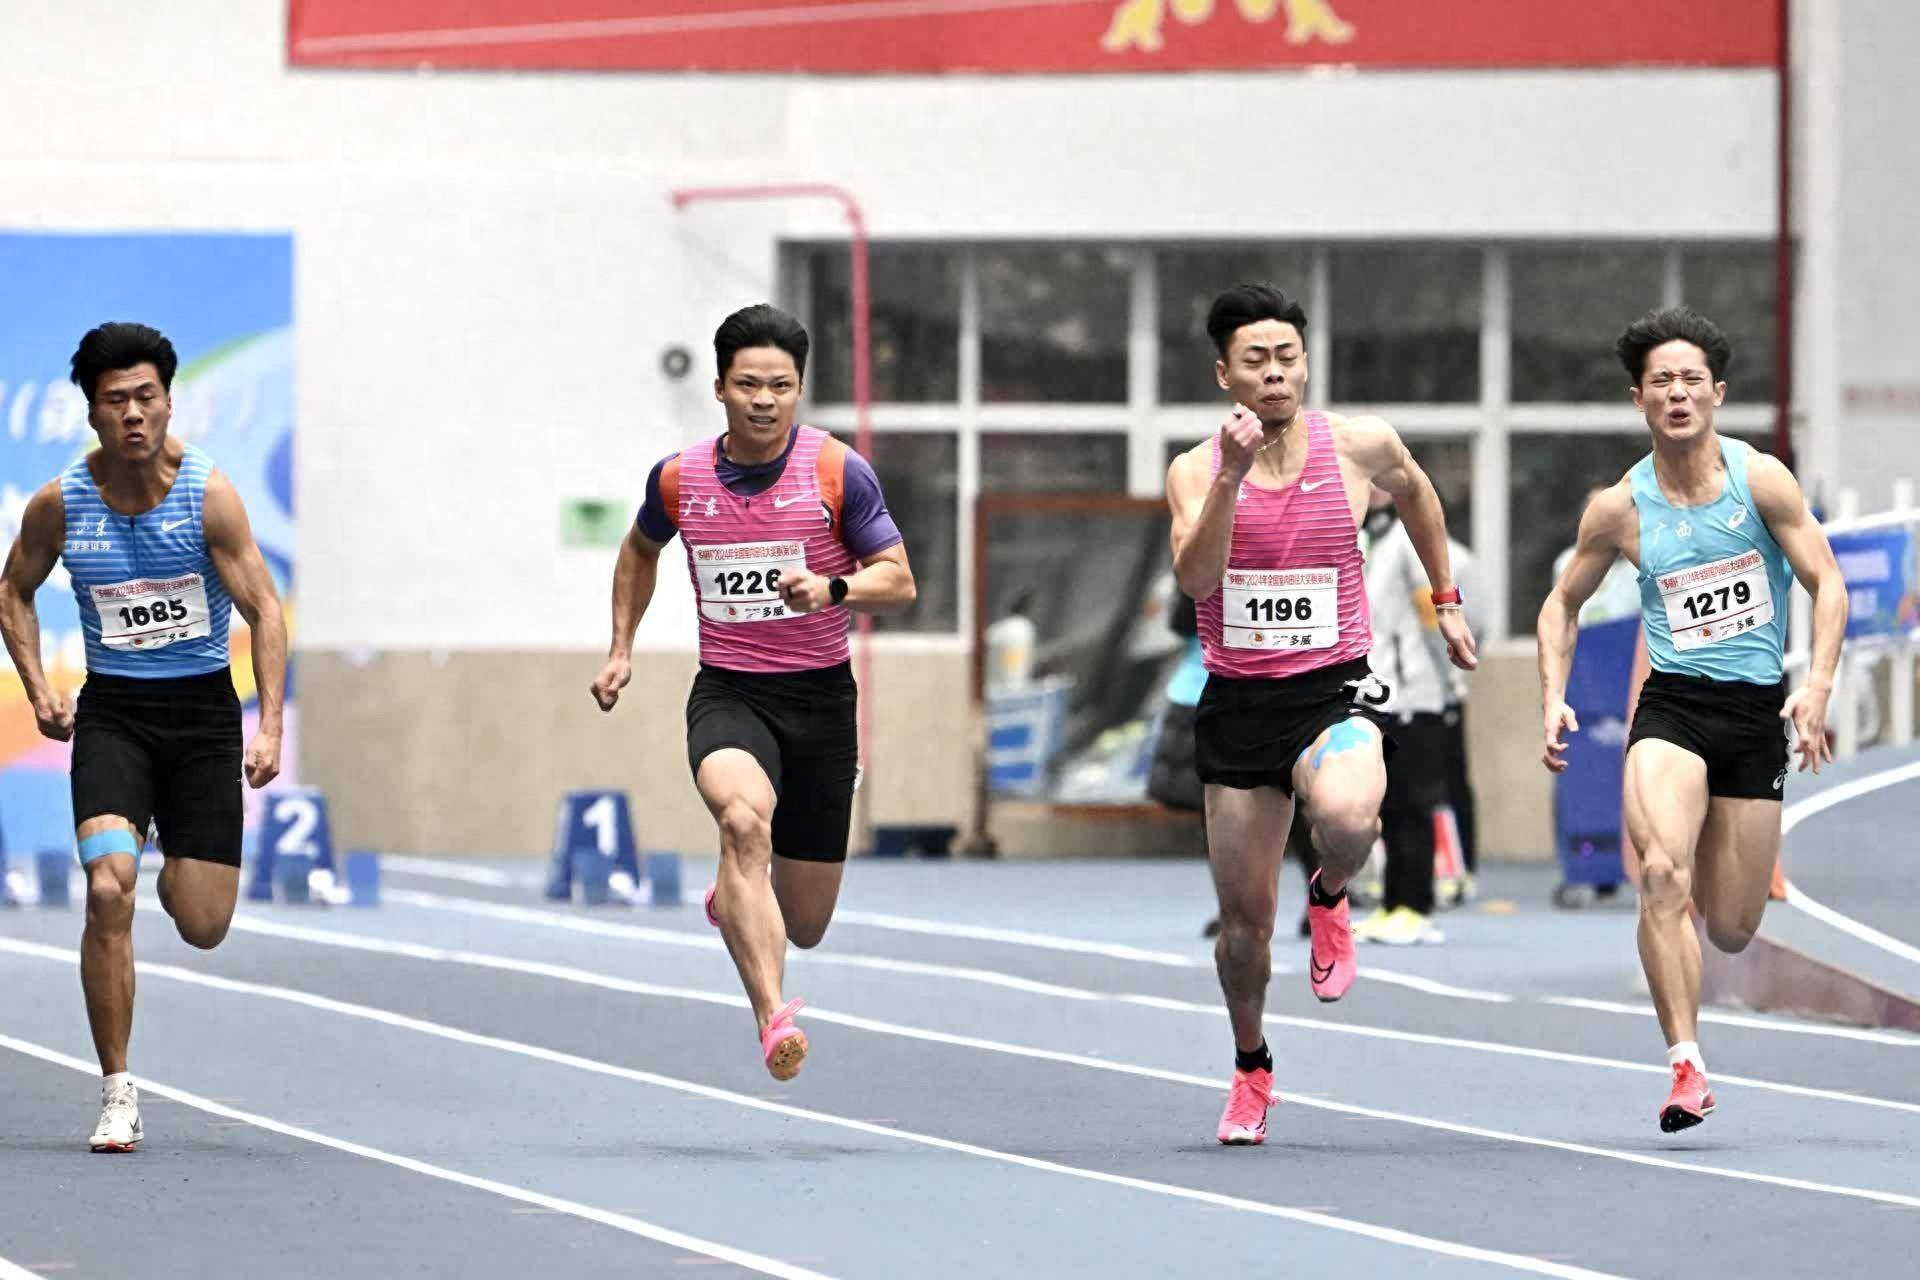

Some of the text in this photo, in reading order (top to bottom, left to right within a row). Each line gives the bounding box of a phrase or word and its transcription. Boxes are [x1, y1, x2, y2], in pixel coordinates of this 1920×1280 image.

[684, 497, 719, 517] 广东
[1655, 520, 1692, 544] 广西
[714, 568, 782, 595] 1226
[762, 605, 784, 617] 多威
[1245, 597, 1312, 621] 1196
[1683, 581, 1750, 619] 1279
[119, 599, 187, 627] 1685
[1736, 616, 1756, 632] 多威
[1290, 634, 1312, 646] 多威
[274, 799, 321, 857] 2
[583, 796, 618, 857] 1
